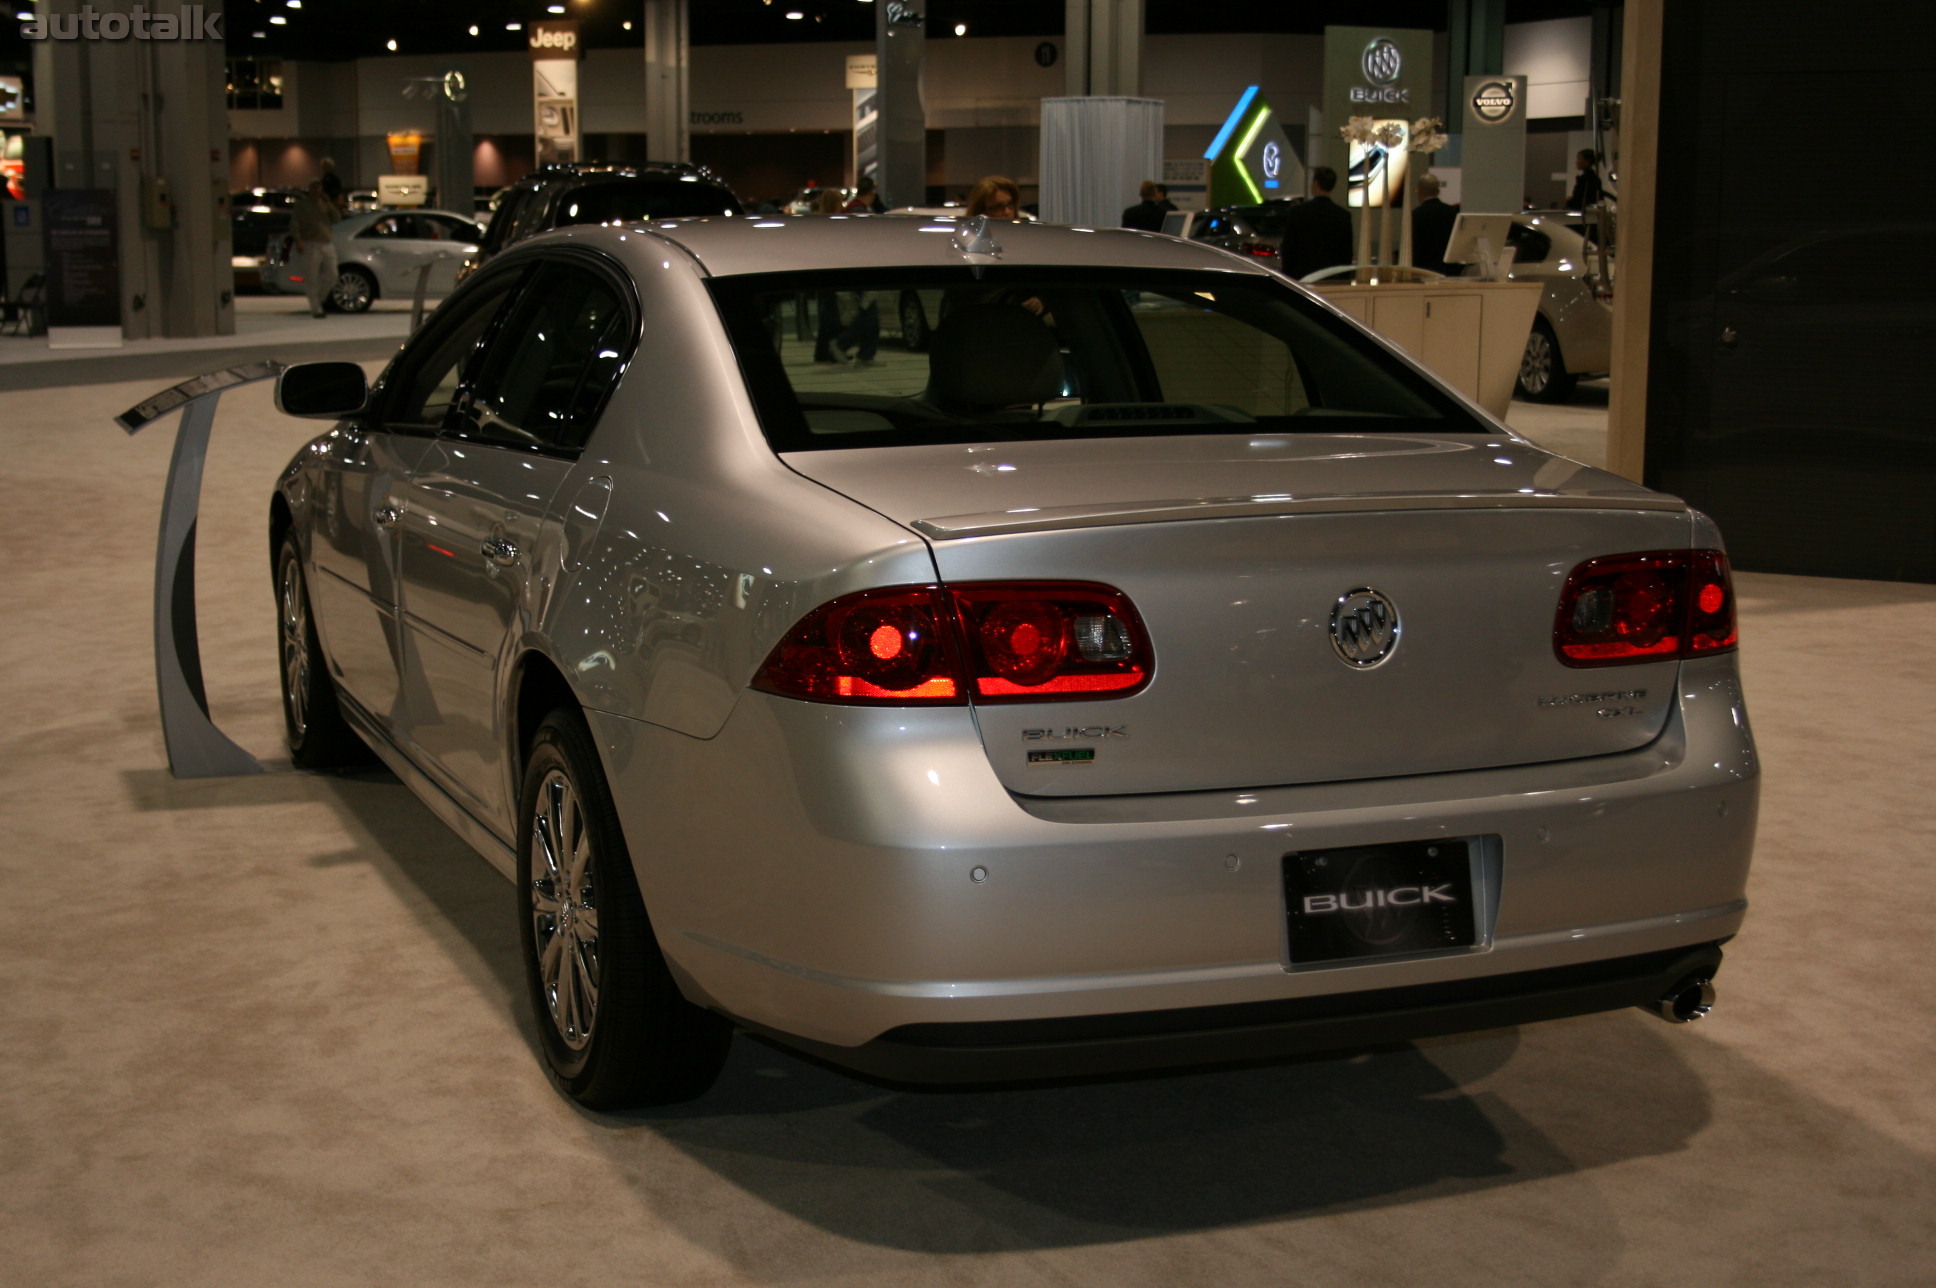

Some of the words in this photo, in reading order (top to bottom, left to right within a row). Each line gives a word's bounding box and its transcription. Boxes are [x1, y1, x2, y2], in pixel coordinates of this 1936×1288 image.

[530, 27, 576, 51] Jeep
[1349, 87, 1409, 103] BUICK
[1476, 98, 1511, 106] VOLVO
[1022, 725, 1129, 740] BUICK
[1303, 883, 1456, 914] BUICK
